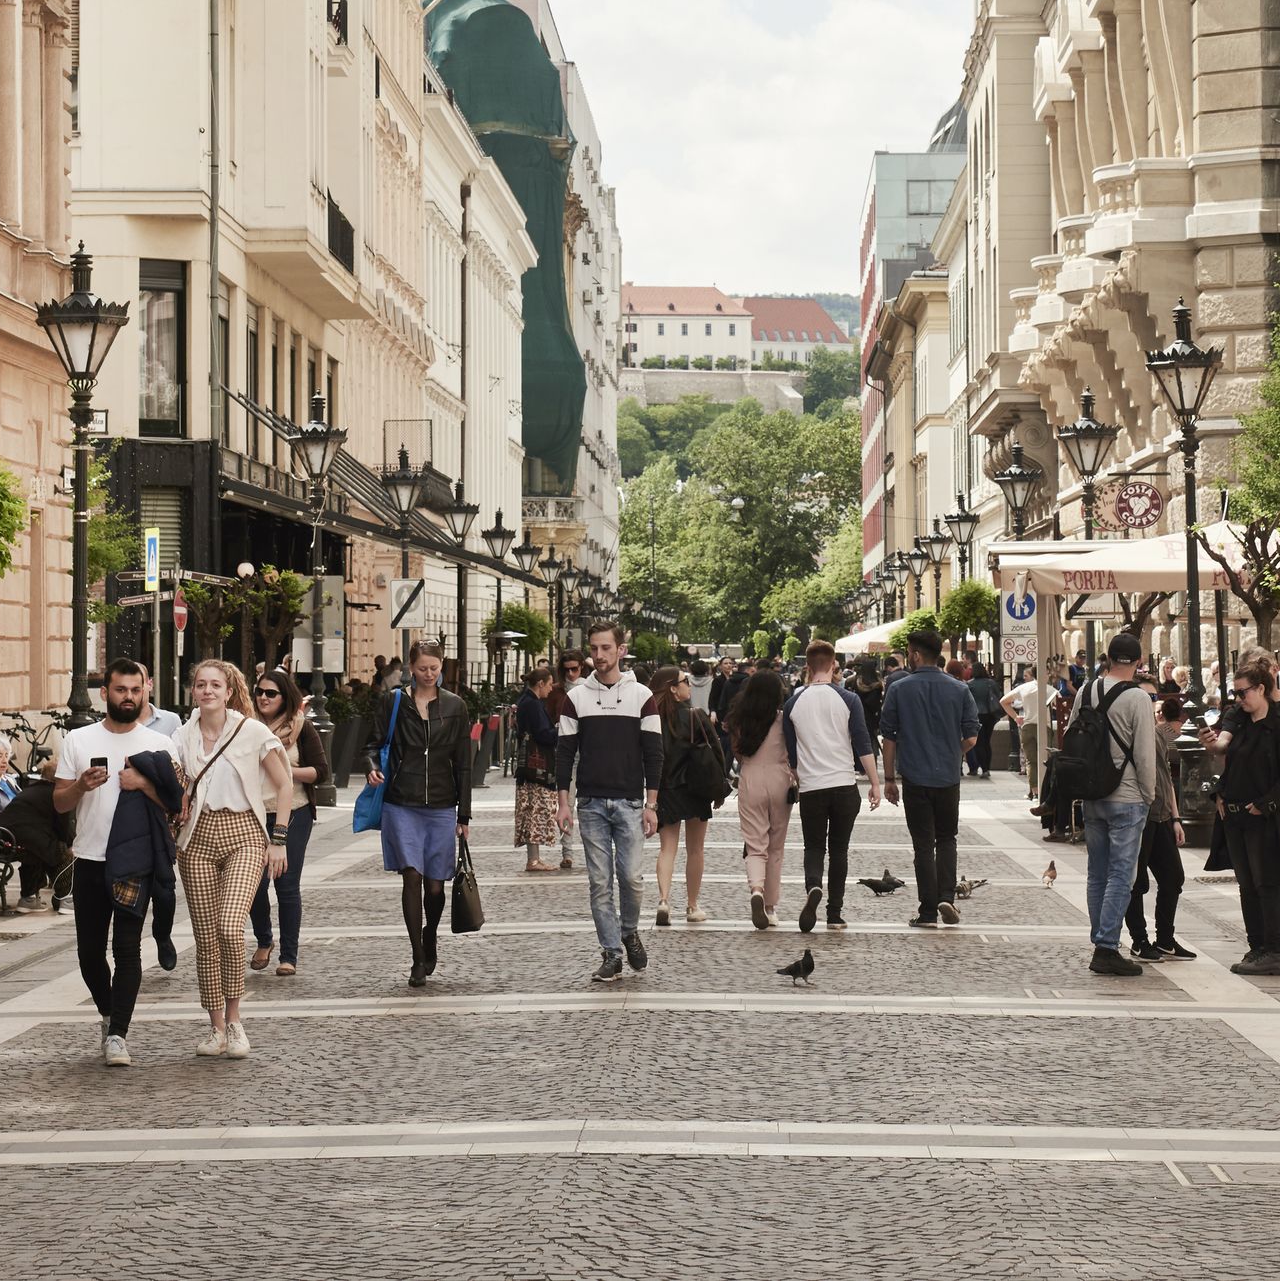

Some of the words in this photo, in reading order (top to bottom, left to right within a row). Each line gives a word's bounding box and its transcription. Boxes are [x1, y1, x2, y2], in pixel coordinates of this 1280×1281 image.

[1122, 485, 1153, 499] COSTA
[1122, 509, 1160, 526] COFFEE
[1062, 570, 1118, 591] PORTA
